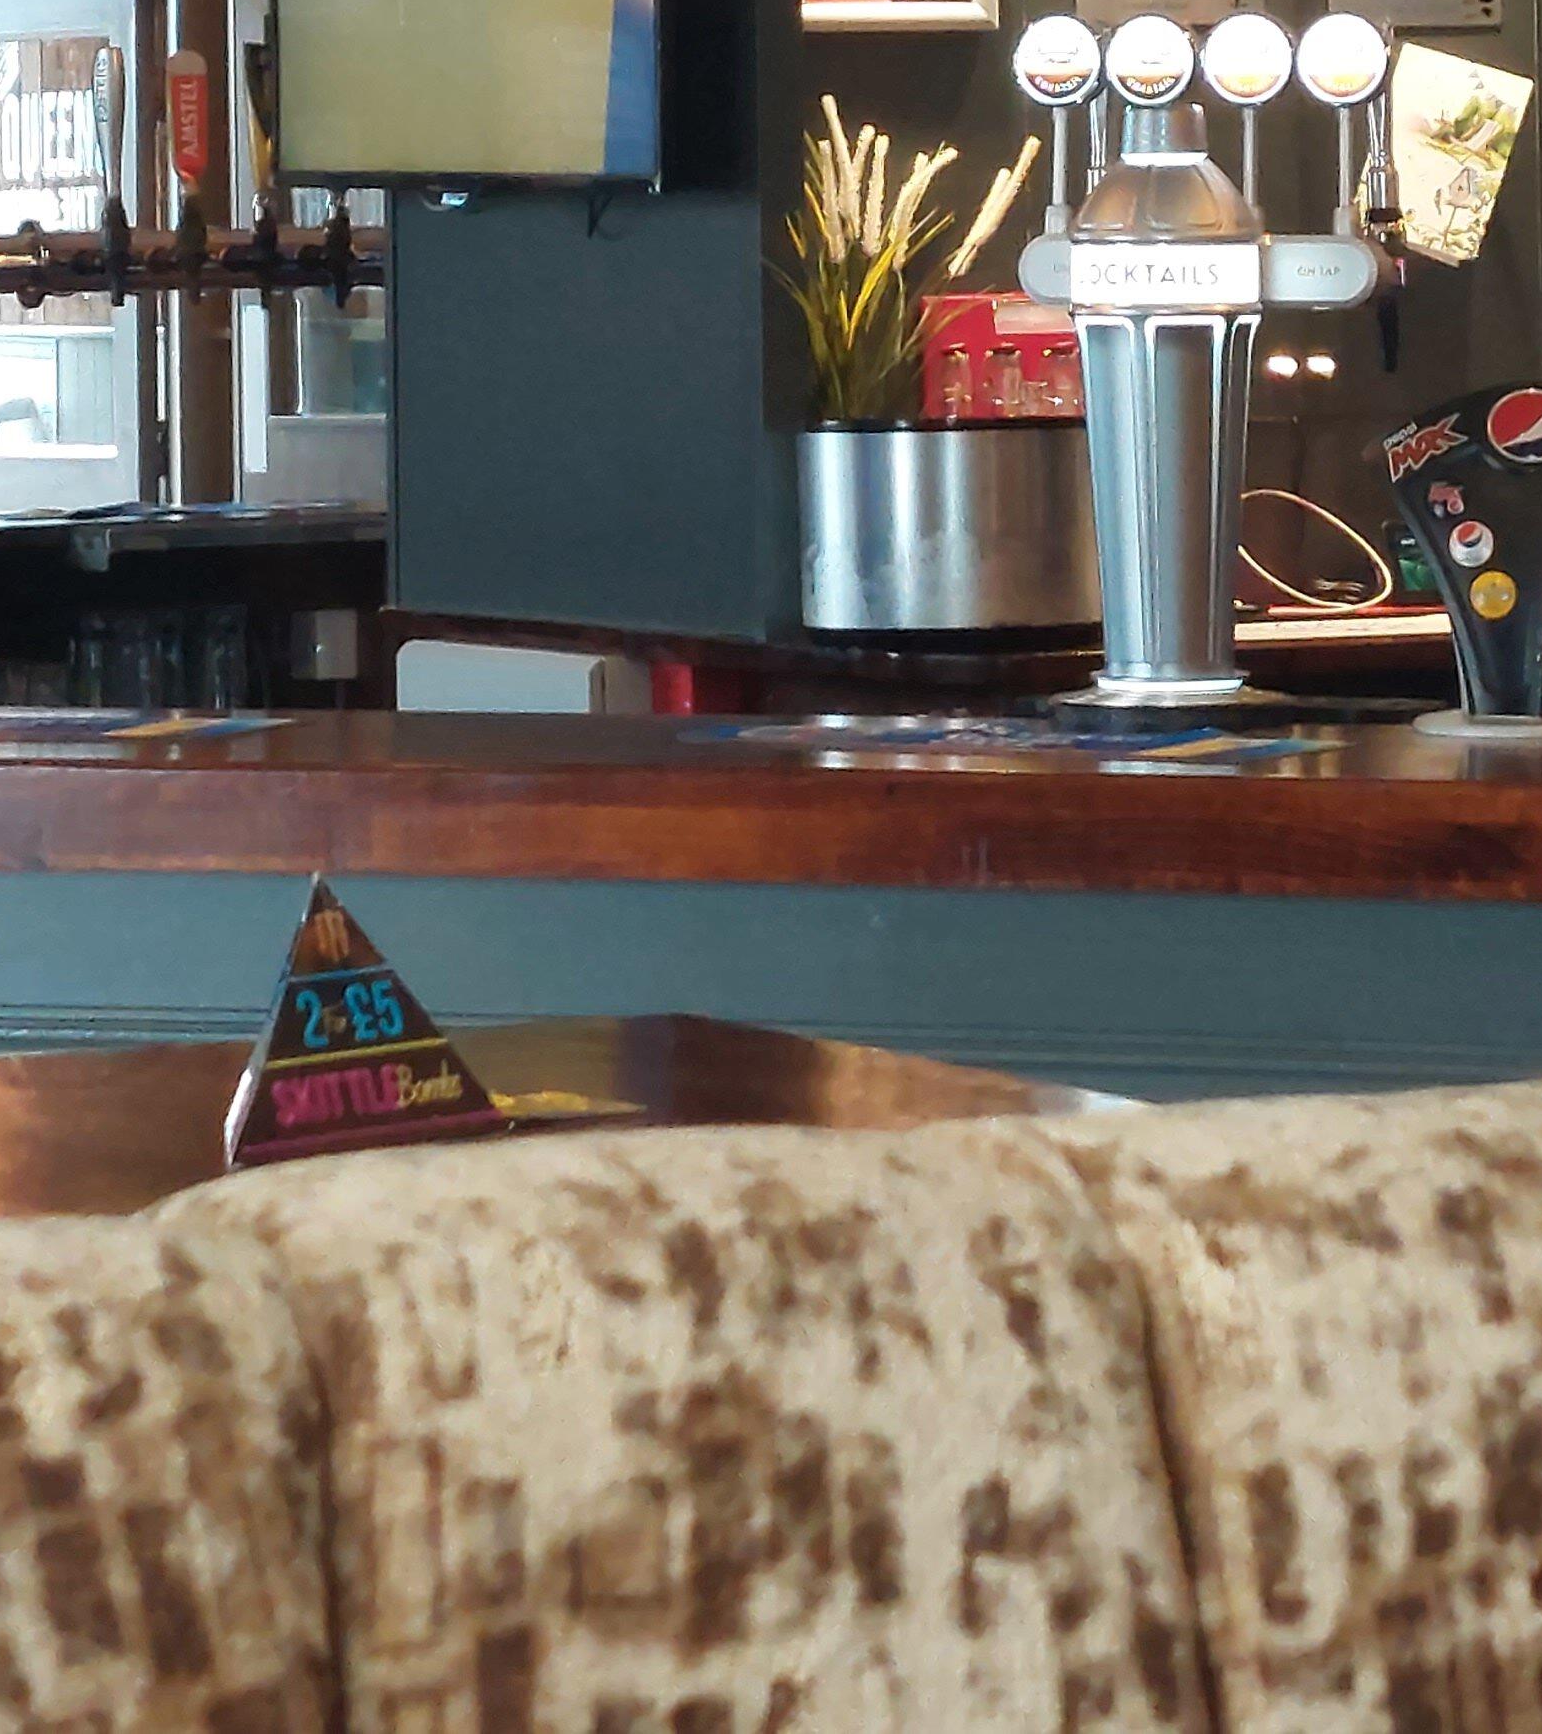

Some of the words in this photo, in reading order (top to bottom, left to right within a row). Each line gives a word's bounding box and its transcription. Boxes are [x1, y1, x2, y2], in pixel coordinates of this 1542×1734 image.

[179, 80, 200, 159] AMSTEL
[1079, 264, 1221, 285] OCKTAILS
[296, 990, 329, 1048] 2
[345, 979, 404, 1042] £5
